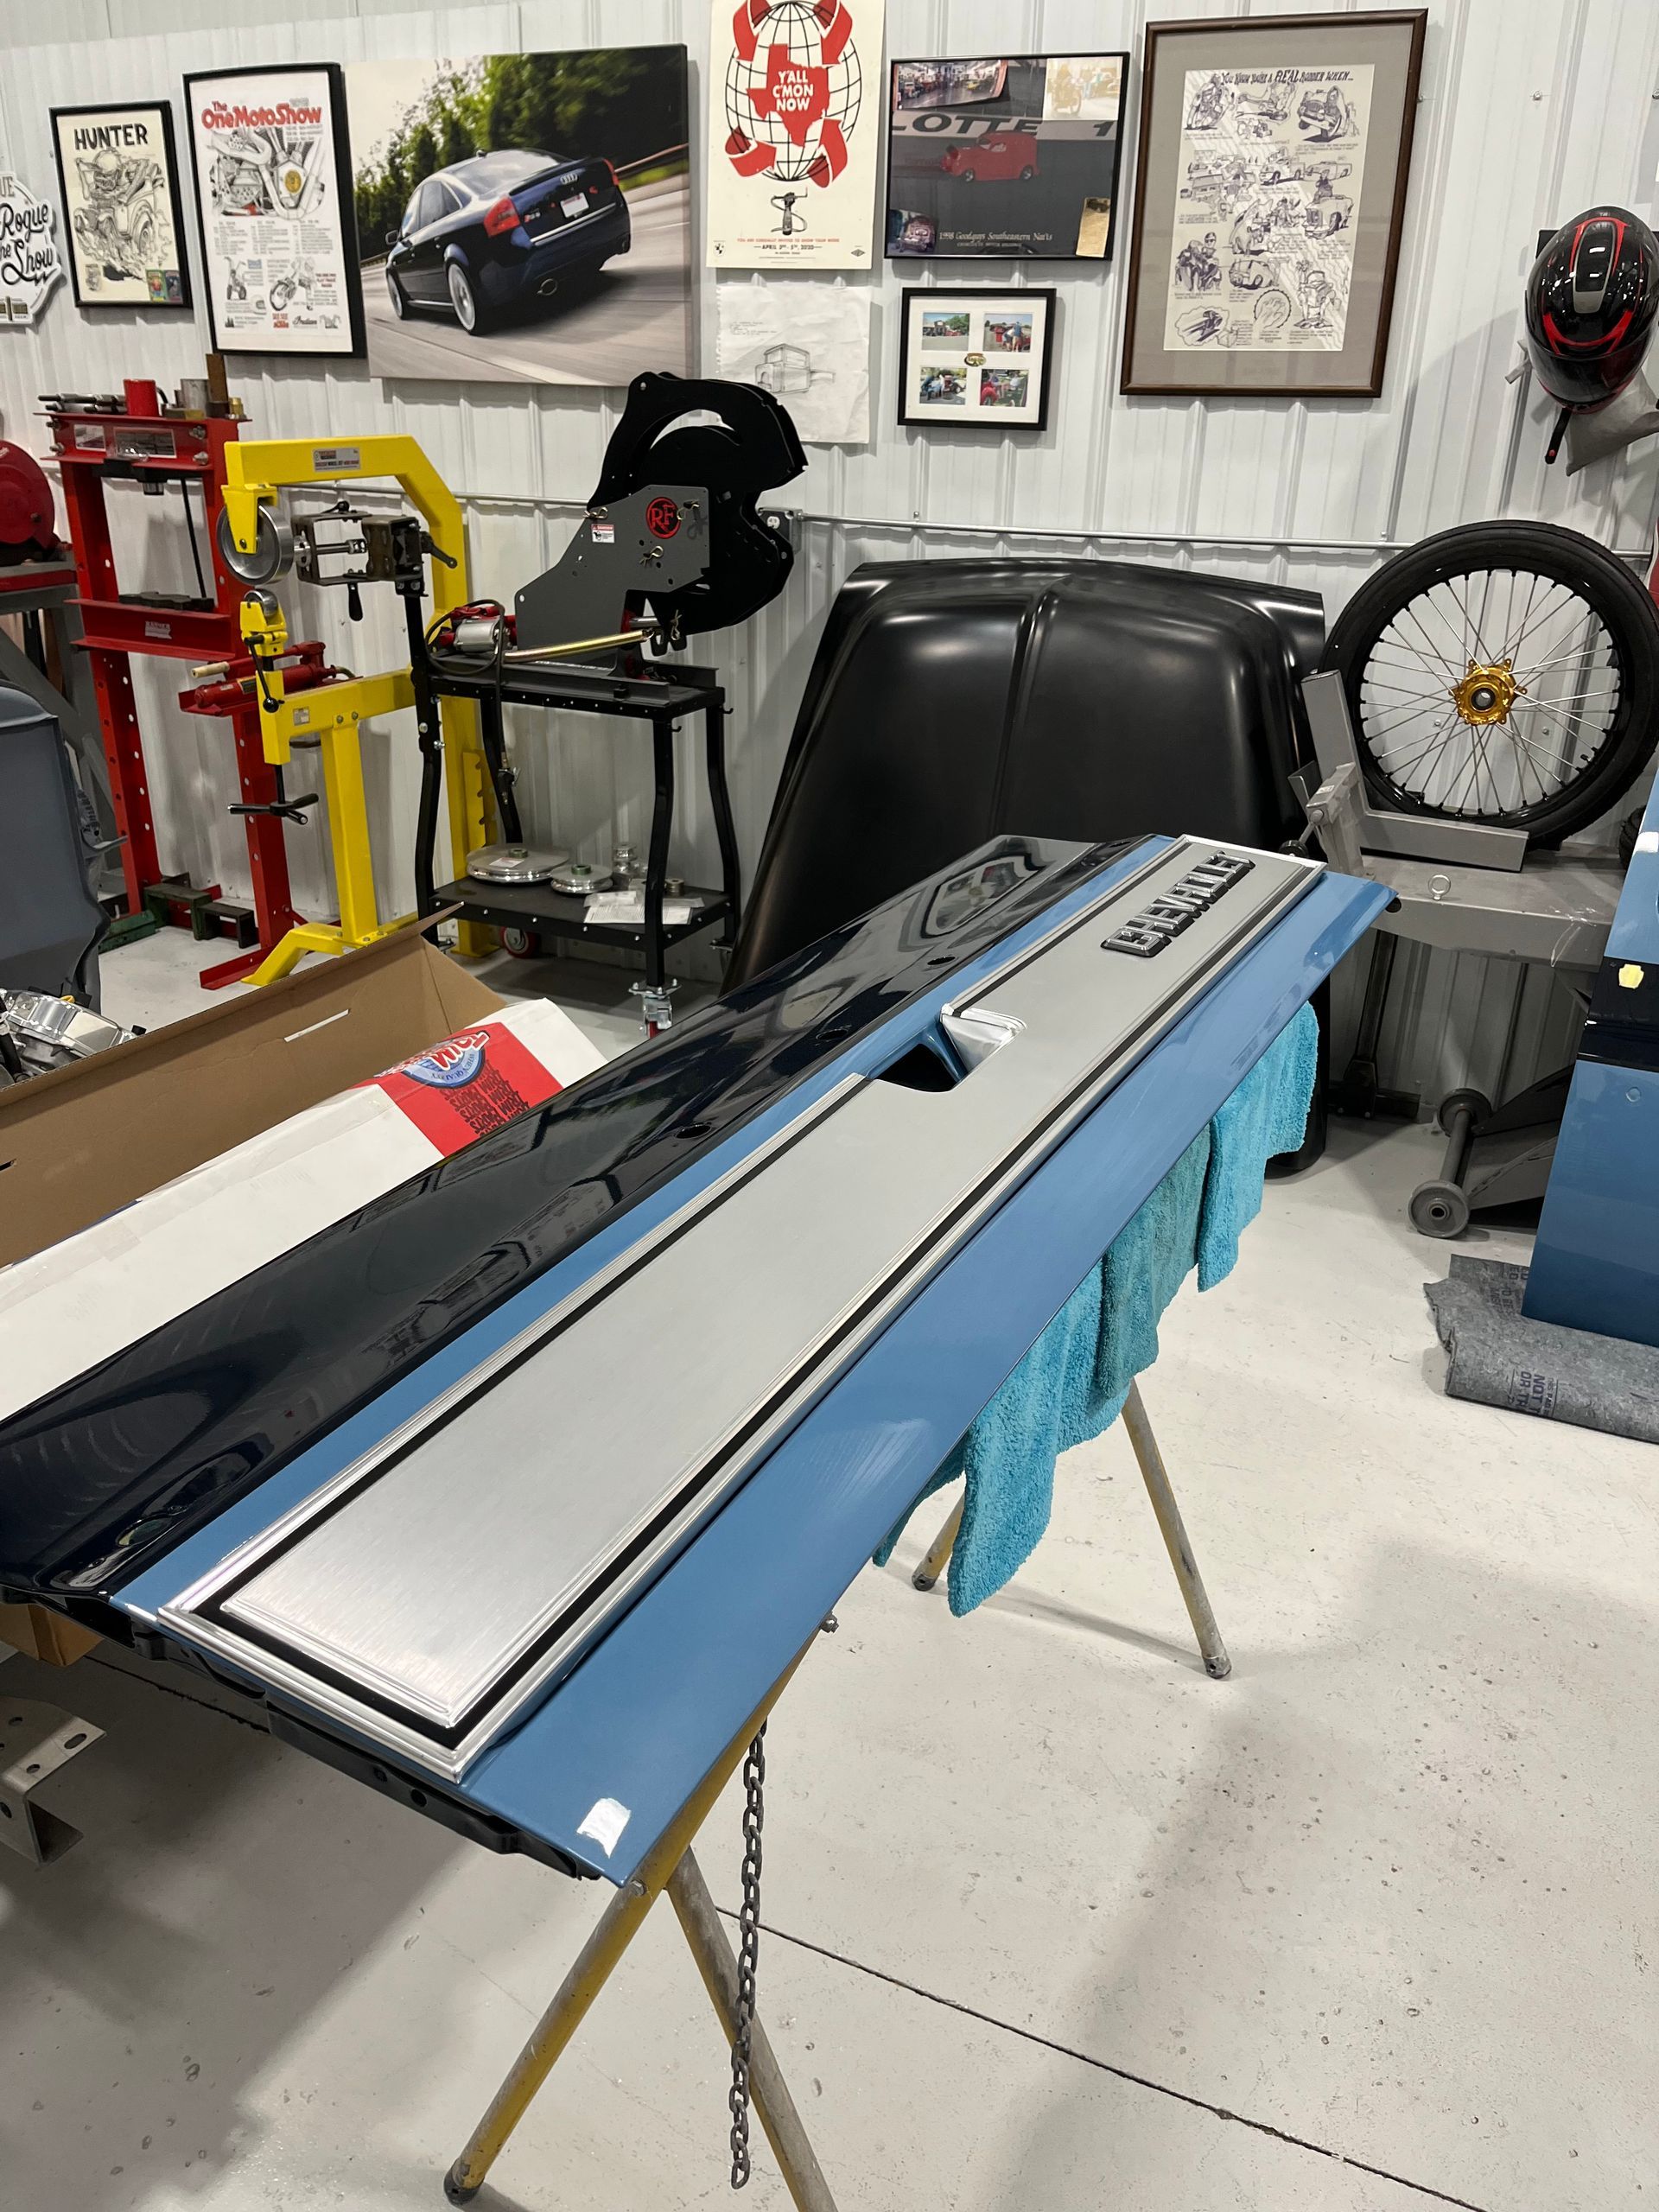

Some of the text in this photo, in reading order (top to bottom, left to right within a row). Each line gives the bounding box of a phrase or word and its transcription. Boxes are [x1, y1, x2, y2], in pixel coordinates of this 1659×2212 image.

[778, 69, 808, 84] Y'ALL
[1274, 69, 1300, 84] REAL
[772, 83, 814, 98] C'MON
[201, 107, 234, 129] One
[232, 105, 276, 127] Moto
[276, 102, 322, 124] Show
[212, 100, 227, 111] The
[776, 97, 810, 111] NOW
[73, 123, 148, 150] HUNTER
[893, 112, 1043, 135] OTTE
[0, 203, 48, 243] Rogue
[3, 238, 54, 285] Show
[651, 503, 677, 533] RF
[1100, 850, 1255, 957] CHEVROLET
[497, 1090, 525, 1116] TRIM
[1520, 1371, 1531, 1388] OR
[1531, 1374, 1546, 1403] NOT
